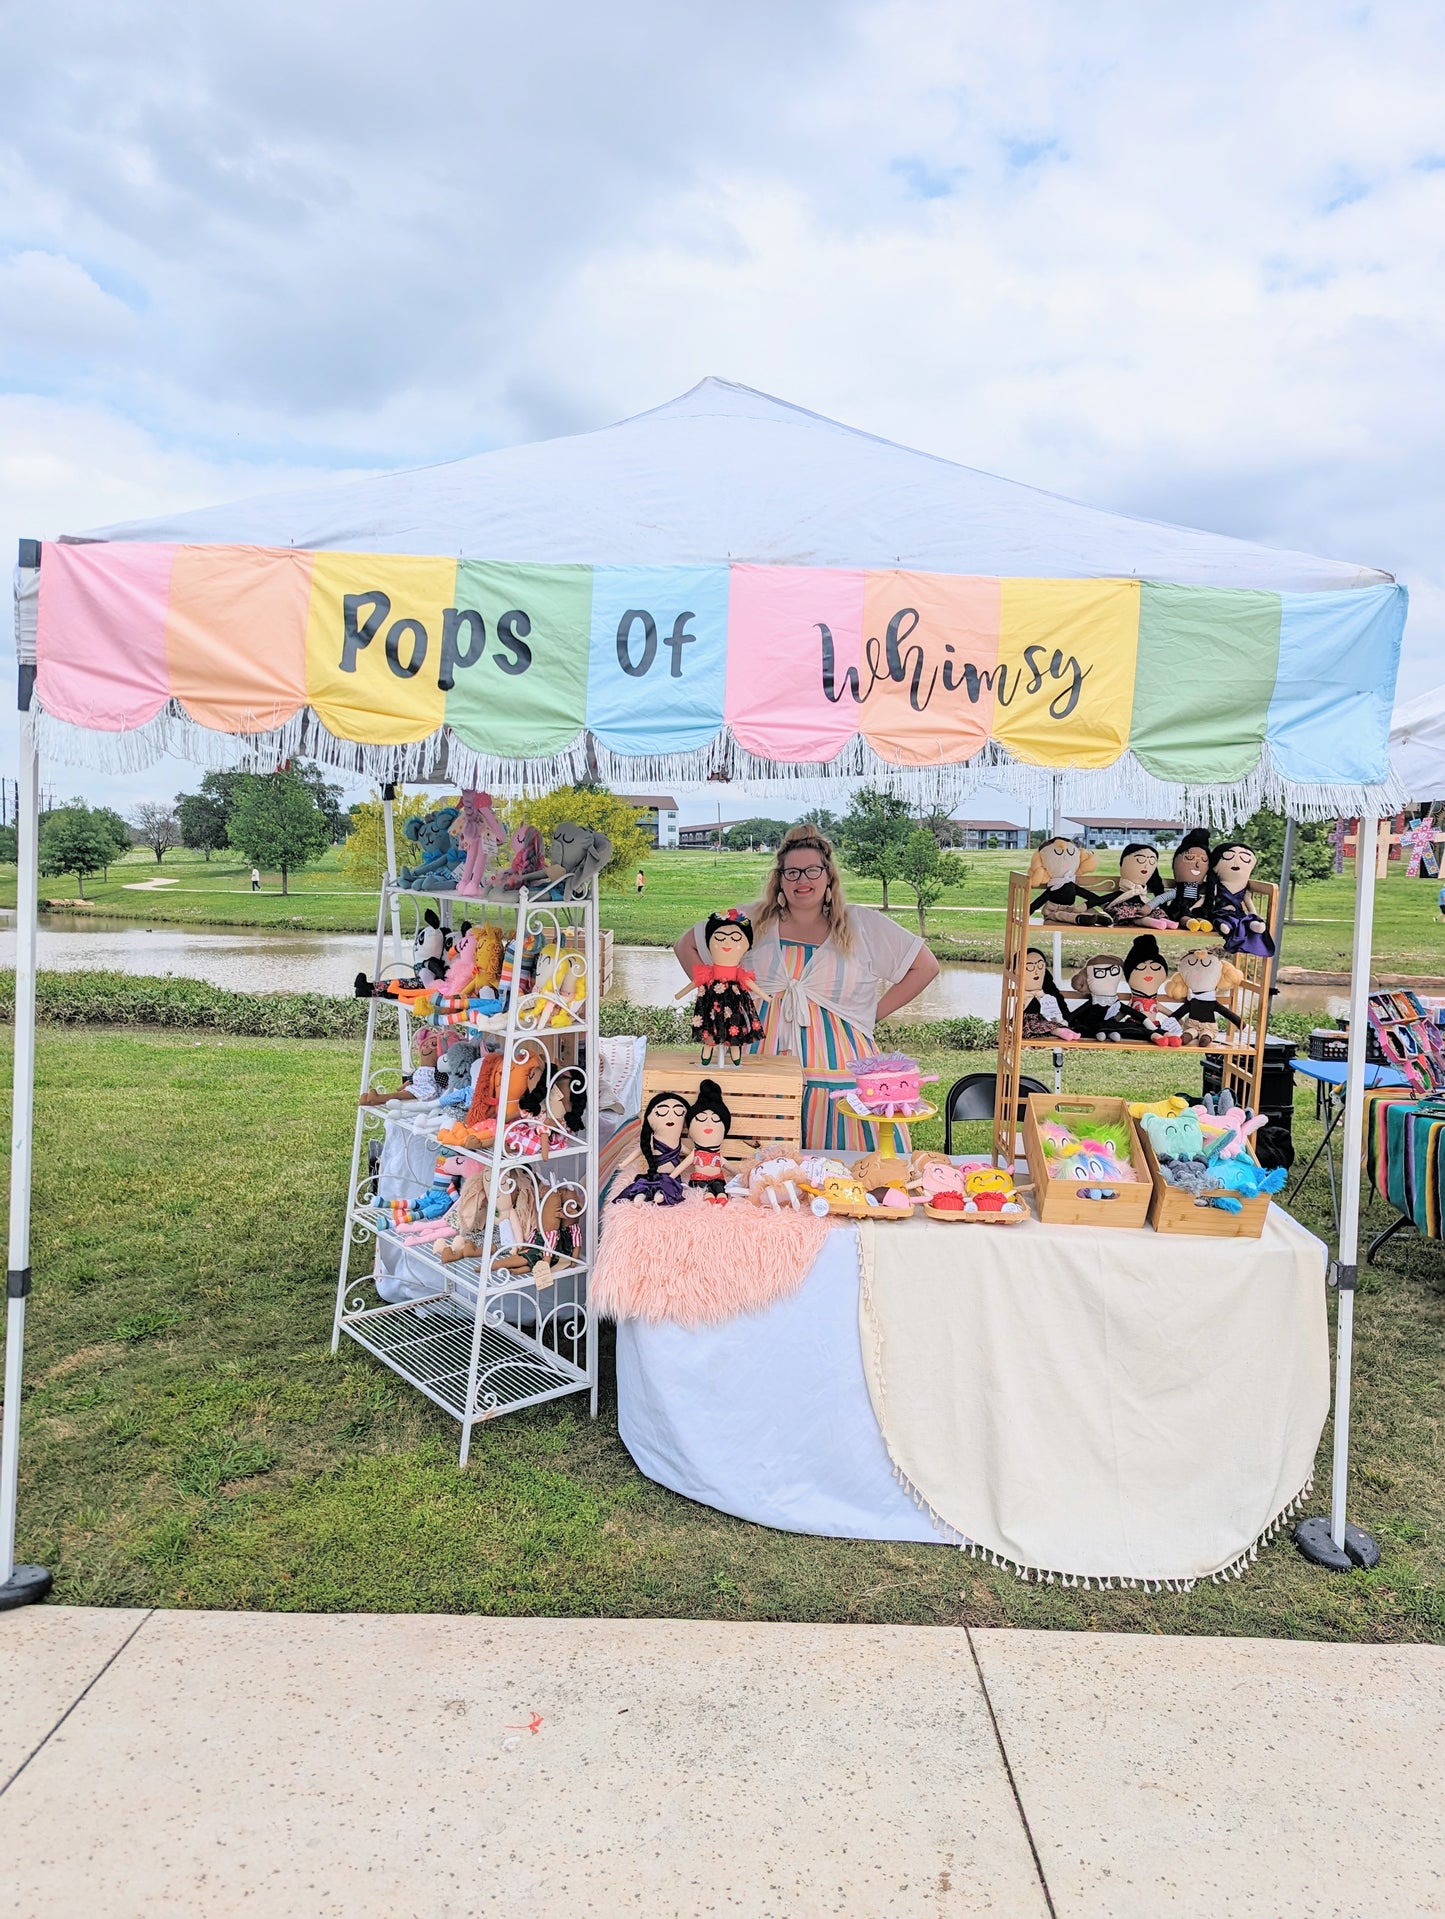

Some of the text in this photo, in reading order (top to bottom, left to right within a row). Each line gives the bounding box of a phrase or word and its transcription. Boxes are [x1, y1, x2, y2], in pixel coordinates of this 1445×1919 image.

[340, 590, 1093, 721] Pops Of Whimsy
